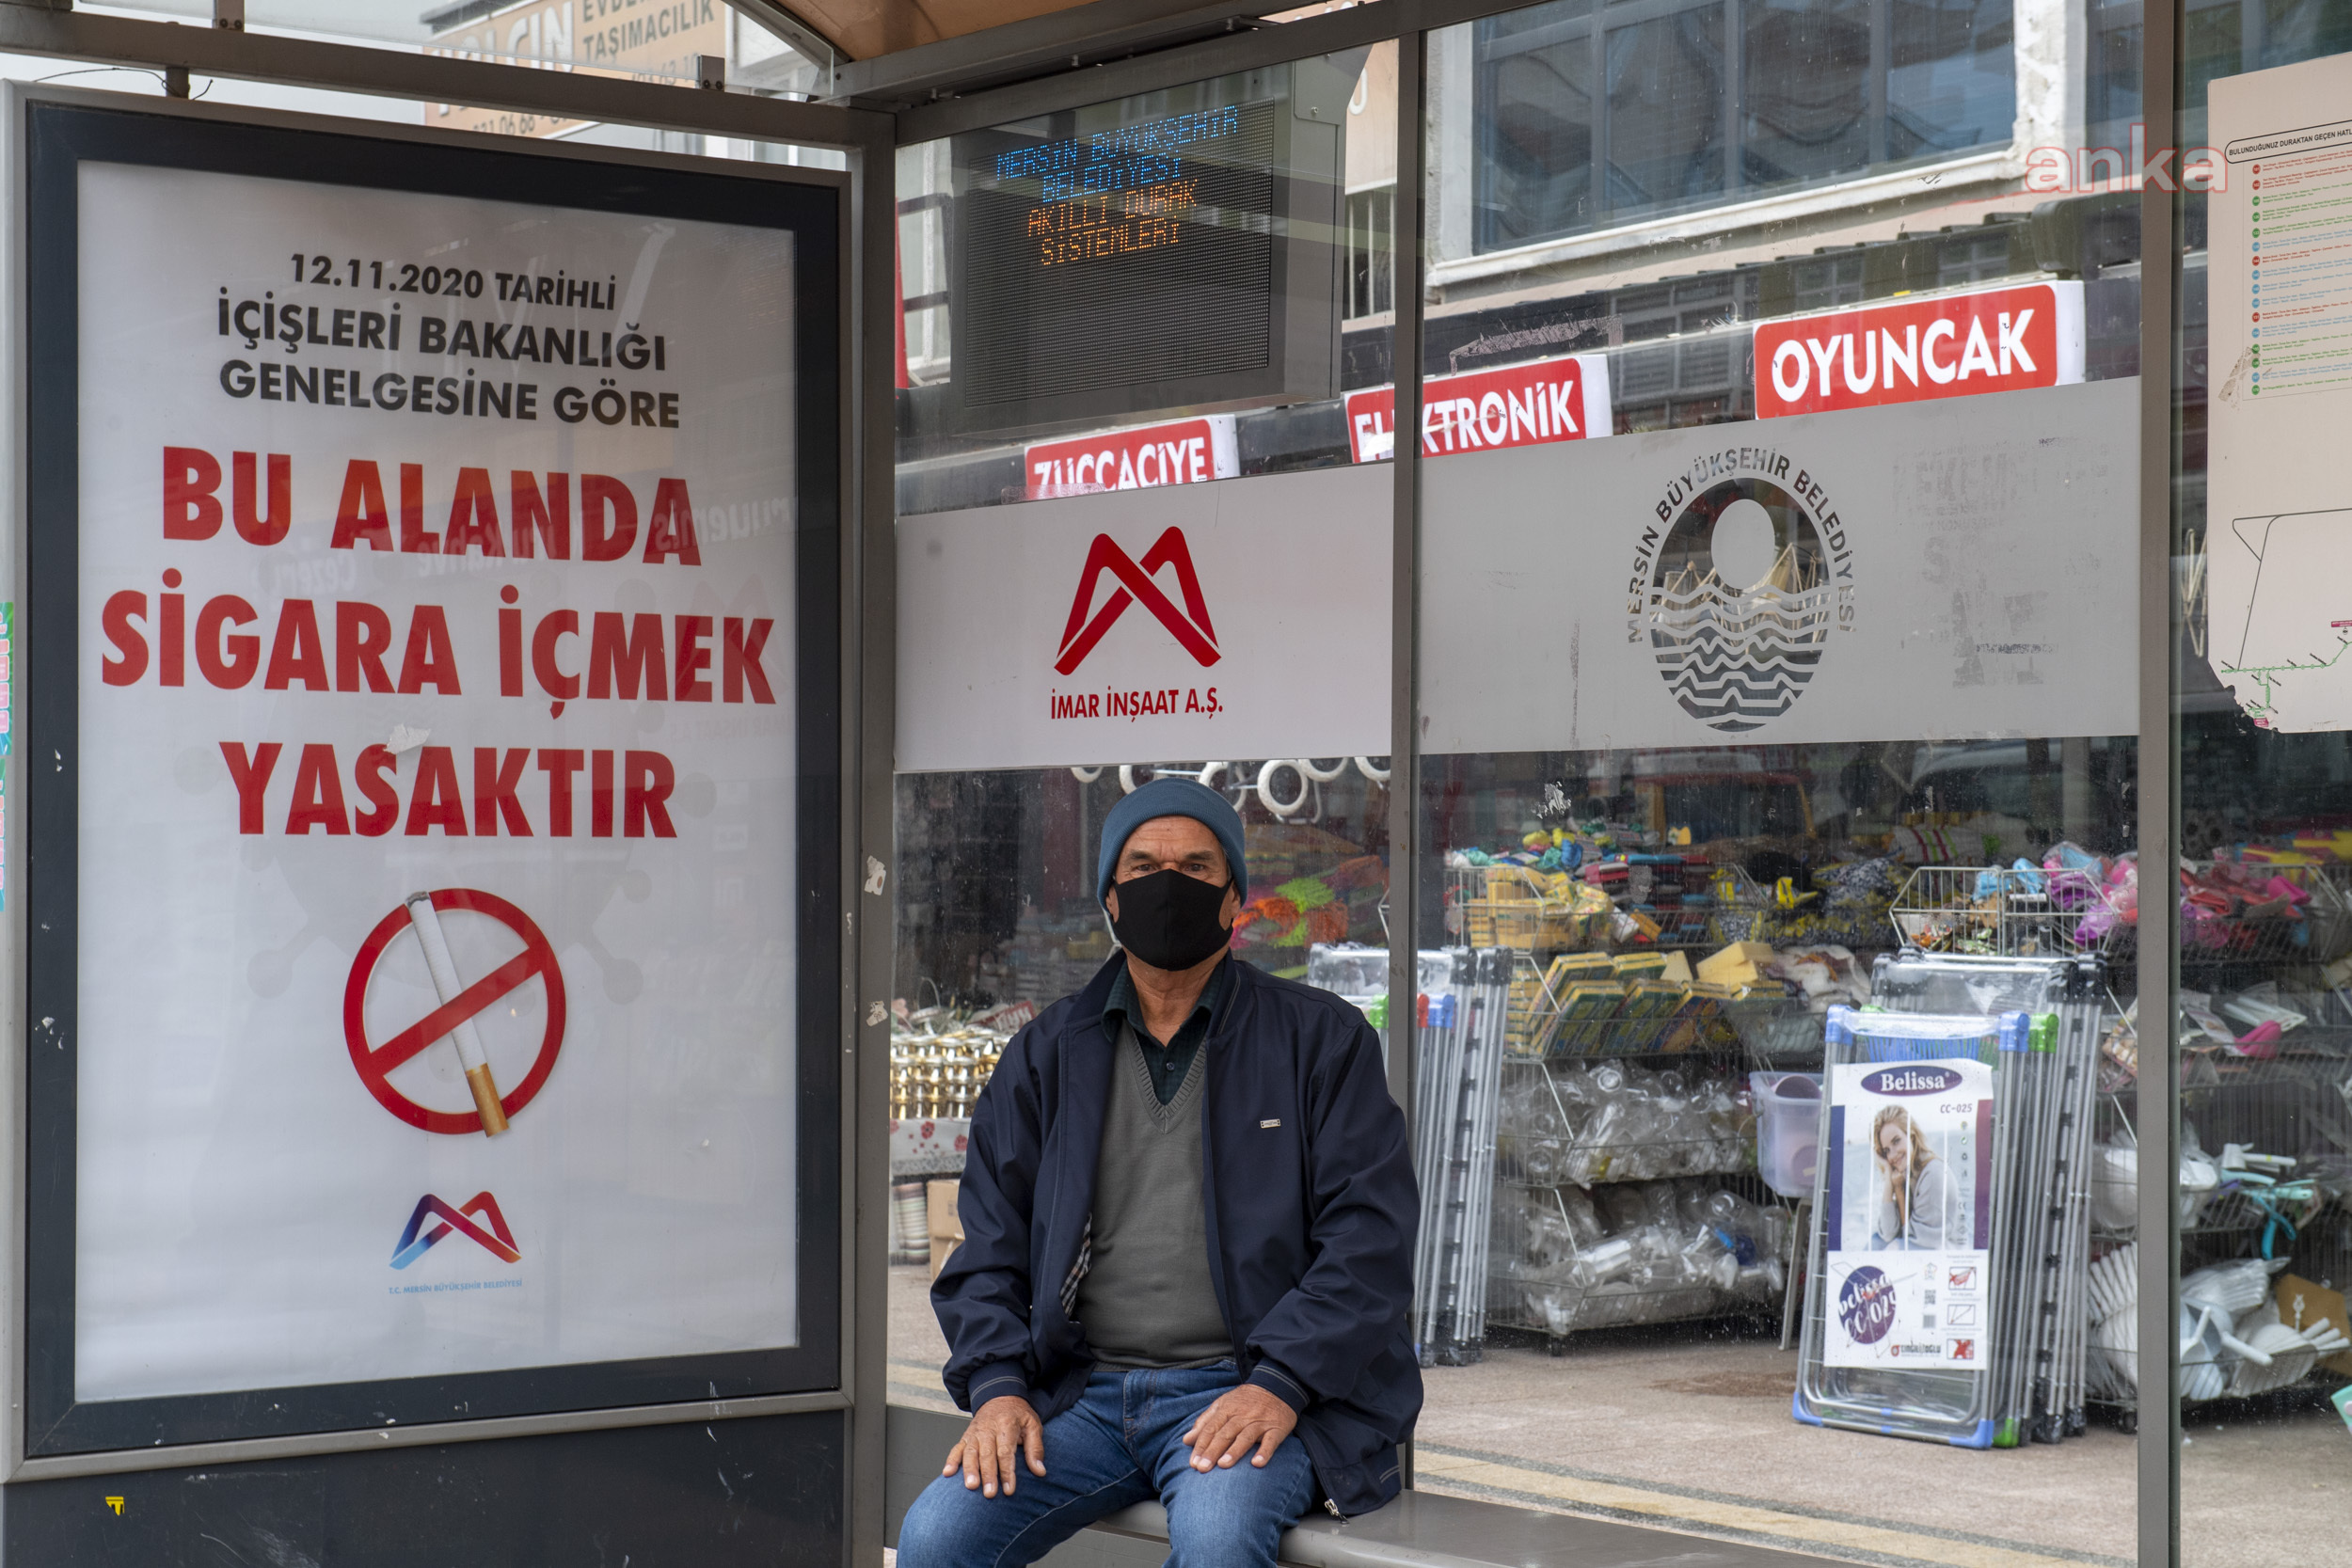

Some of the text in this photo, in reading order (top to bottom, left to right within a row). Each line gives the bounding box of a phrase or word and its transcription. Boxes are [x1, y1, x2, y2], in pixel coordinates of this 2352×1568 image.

[2229, 141, 2279, 156] BULUNDUĞUNUZ
[2280, 135, 2313, 148] DURAKTAN
[2314, 131, 2336, 141] GEÇEN
[1028, 179, 1198, 237] AKILLI DURAK
[290, 252, 617, 311] 12.11.2020 TARİHLİ
[217, 286, 666, 372] İÇİŞLERİ BAKANLIĞI
[1772, 309, 2038, 403] OYUNCAK
[218, 358, 681, 431] GENELGESİNE GÖRE
[1354, 380, 1580, 462] ELKTRONİK
[162, 445, 702, 566] BU ALANDA
[1627, 525, 1660, 643] MERSİN
[1655, 447, 1790, 523] BÜYÜKŞEHİR
[1793, 468, 1857, 632] BELEDİYESİ
[101, 567, 462, 696] SİGARA
[498, 584, 776, 720] İÇMEK
[1051, 685, 1224, 723] İMAR İNŞAAT A.Ş.
[218, 741, 677, 839] YASAKTIR
[1881, 1070, 1947, 1092] Belissa
[1940, 1103, 1973, 1114] CC-025
[403, 1284, 432, 1294] MERSİN
[434, 1281, 482, 1292] BÜYÜKŞEHİR
[483, 1278, 522, 1290] BELEDİYESİ
